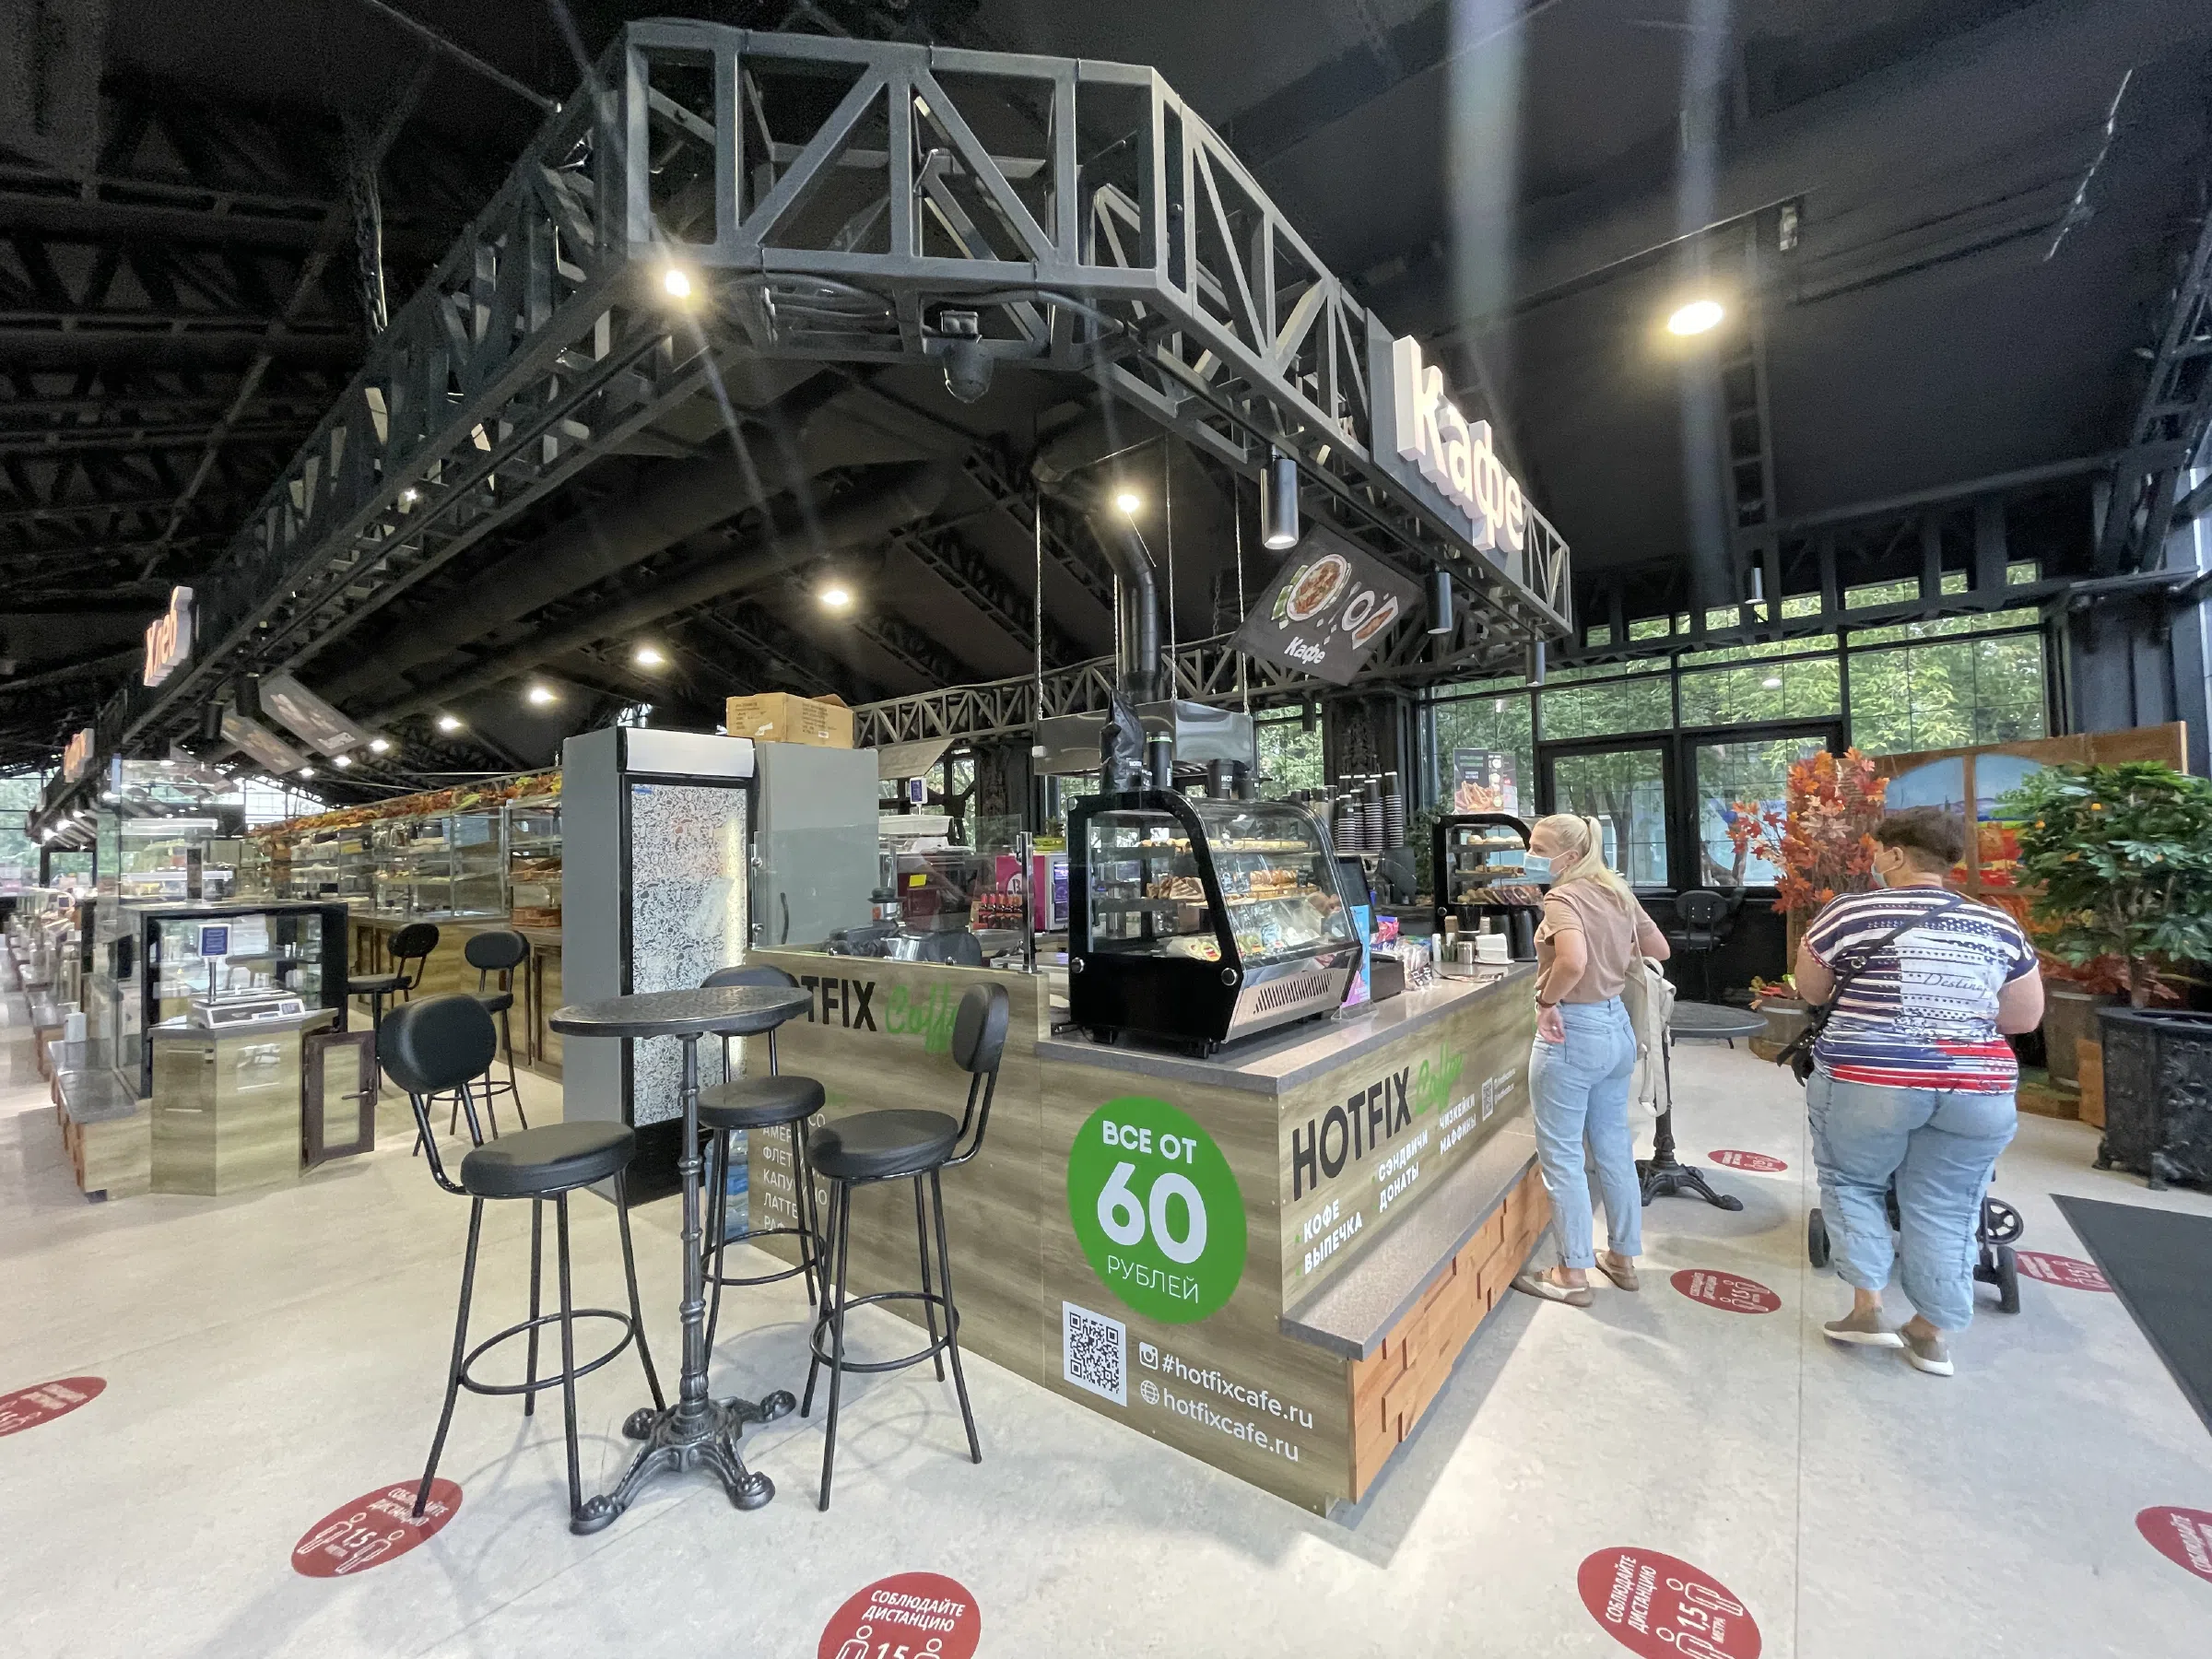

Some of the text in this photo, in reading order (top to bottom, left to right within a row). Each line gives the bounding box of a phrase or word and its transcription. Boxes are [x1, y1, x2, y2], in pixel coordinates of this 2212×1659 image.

[1393, 335, 1524, 552] Кафе
[1284, 636, 1325, 664] Кафе
[801, 975, 959, 1054] TFIX Coff
[1292, 1066, 1412, 1202] HOTFIX
[1439, 1093, 1476, 1130] ЧИЗКЕЙКИ
[1440, 1113, 1477, 1156] МАФФИНЫ
[1102, 1120, 1197, 1164] ВСЕ ОТ
[1378, 1129, 1428, 1182] СЭНДВИЧИ
[1097, 1161, 1207, 1264] 60
[1379, 1161, 1419, 1213] ДОНАТЫ
[1303, 1198, 1339, 1242] КОФЕ
[1304, 1211, 1363, 1275] ВЫПЕЧКА
[1108, 1254, 1198, 1304] РУБЛЕЙ
[1161, 1353, 1313, 1430] #hotfixcafe.ru
[1163, 1387, 1299, 1462] hotfixcafe.ru
[871, 1589, 966, 1618] СОБЛЮДАЙТЕ
[1605, 1554, 1637, 1624] СОБЛЮДАЙТЕ
[1628, 1565, 1658, 1635] ДИСТАНЦИЮ
[861, 1606, 955, 1632] ДИСТАНЦИЮ
[1677, 1602, 1711, 1631] 1,5
